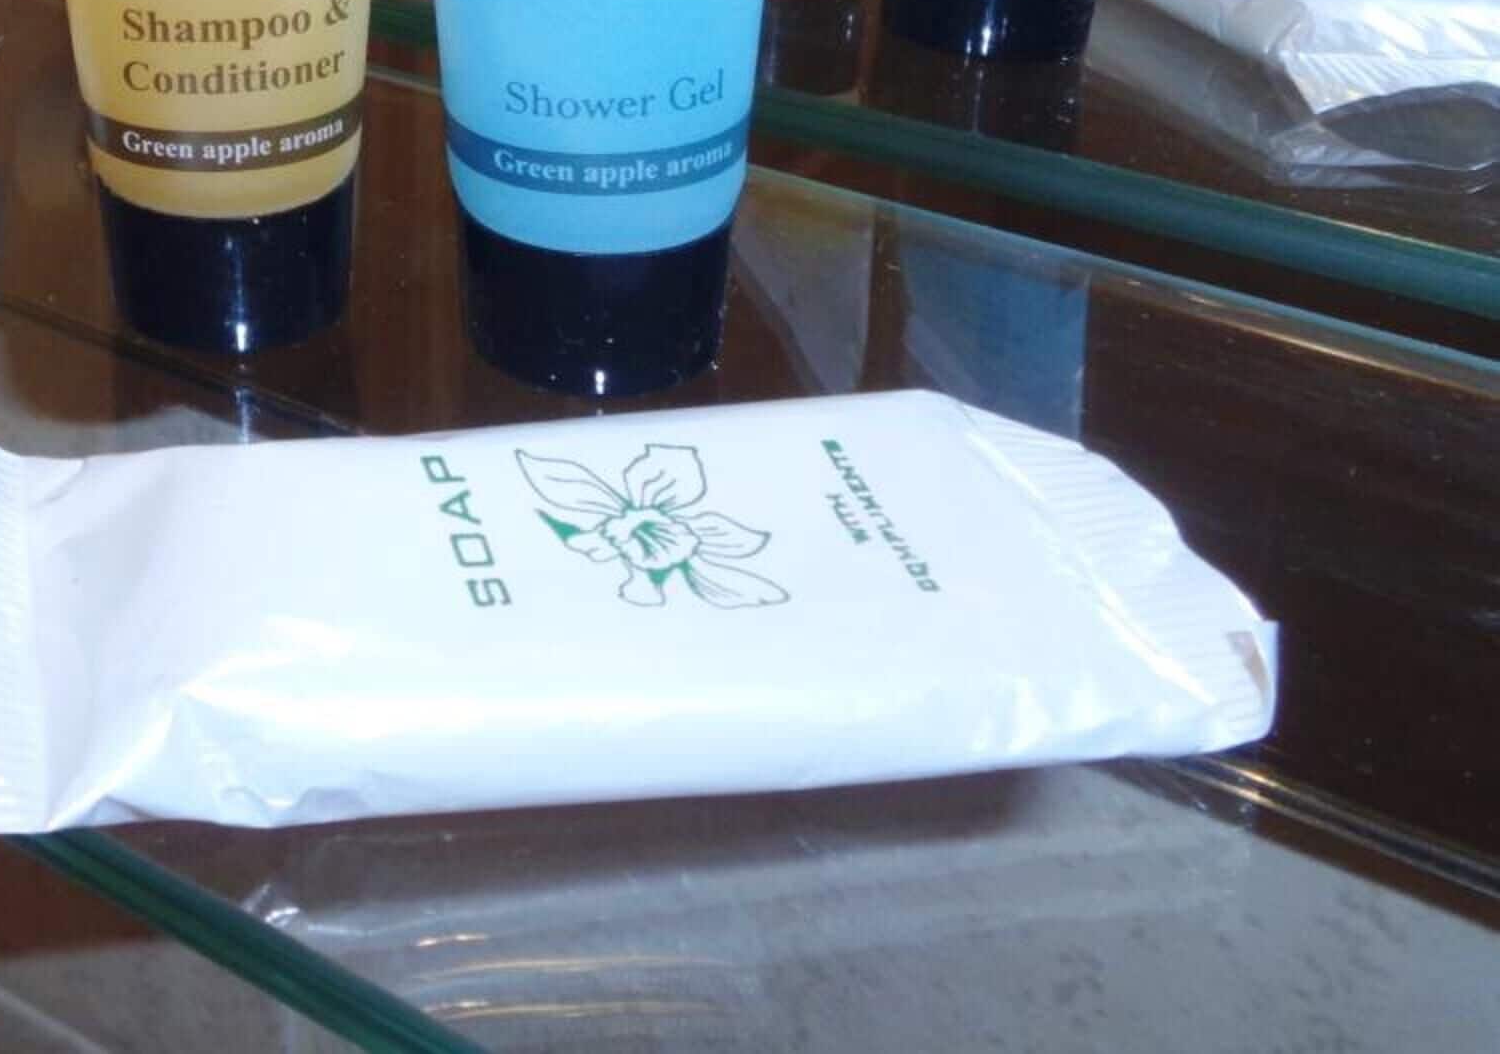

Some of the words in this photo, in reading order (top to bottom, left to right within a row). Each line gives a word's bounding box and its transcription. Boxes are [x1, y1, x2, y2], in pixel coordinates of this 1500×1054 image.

[122, 7, 312, 50] Shampoo
[122, 50, 346, 96] Conditioner
[505, 81, 656, 120] Shower
[668, 67, 724, 112] Gel
[122, 130, 194, 160] Green
[202, 136, 272, 164] apple
[279, 118, 343, 153] aroma
[494, 148, 575, 183] Green
[582, 160, 660, 189] apple
[666, 141, 733, 177] aroma
[419, 453, 512, 607] SOAP
[824, 491, 871, 546] WITH
